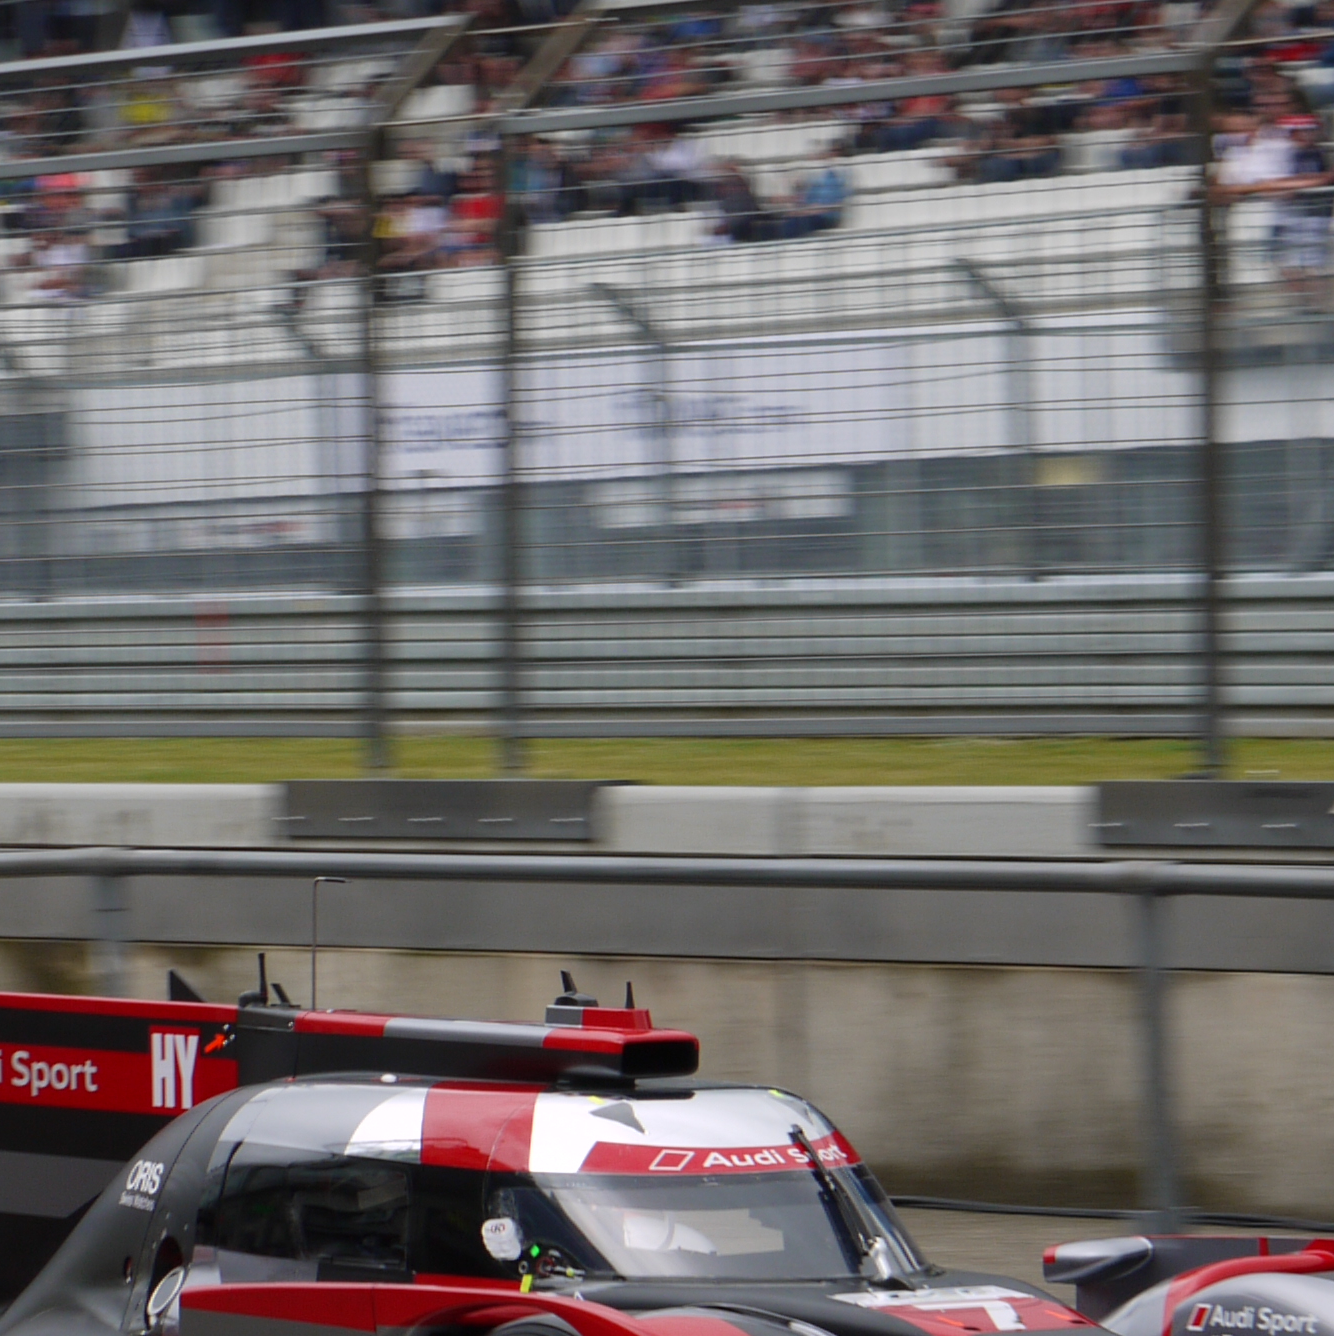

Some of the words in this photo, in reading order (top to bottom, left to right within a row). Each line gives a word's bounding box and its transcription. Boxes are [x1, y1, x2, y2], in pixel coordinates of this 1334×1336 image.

[12, 1049, 98, 1097] Sport
[151, 1033, 200, 1110] HY
[703, 1148, 786, 1169] Audi
[787, 1144, 848, 1164] Sort
[126, 1159, 165, 1195] ORIS
[1209, 1304, 1255, 1329] Audi
[1257, 1307, 1319, 1336] Sport
